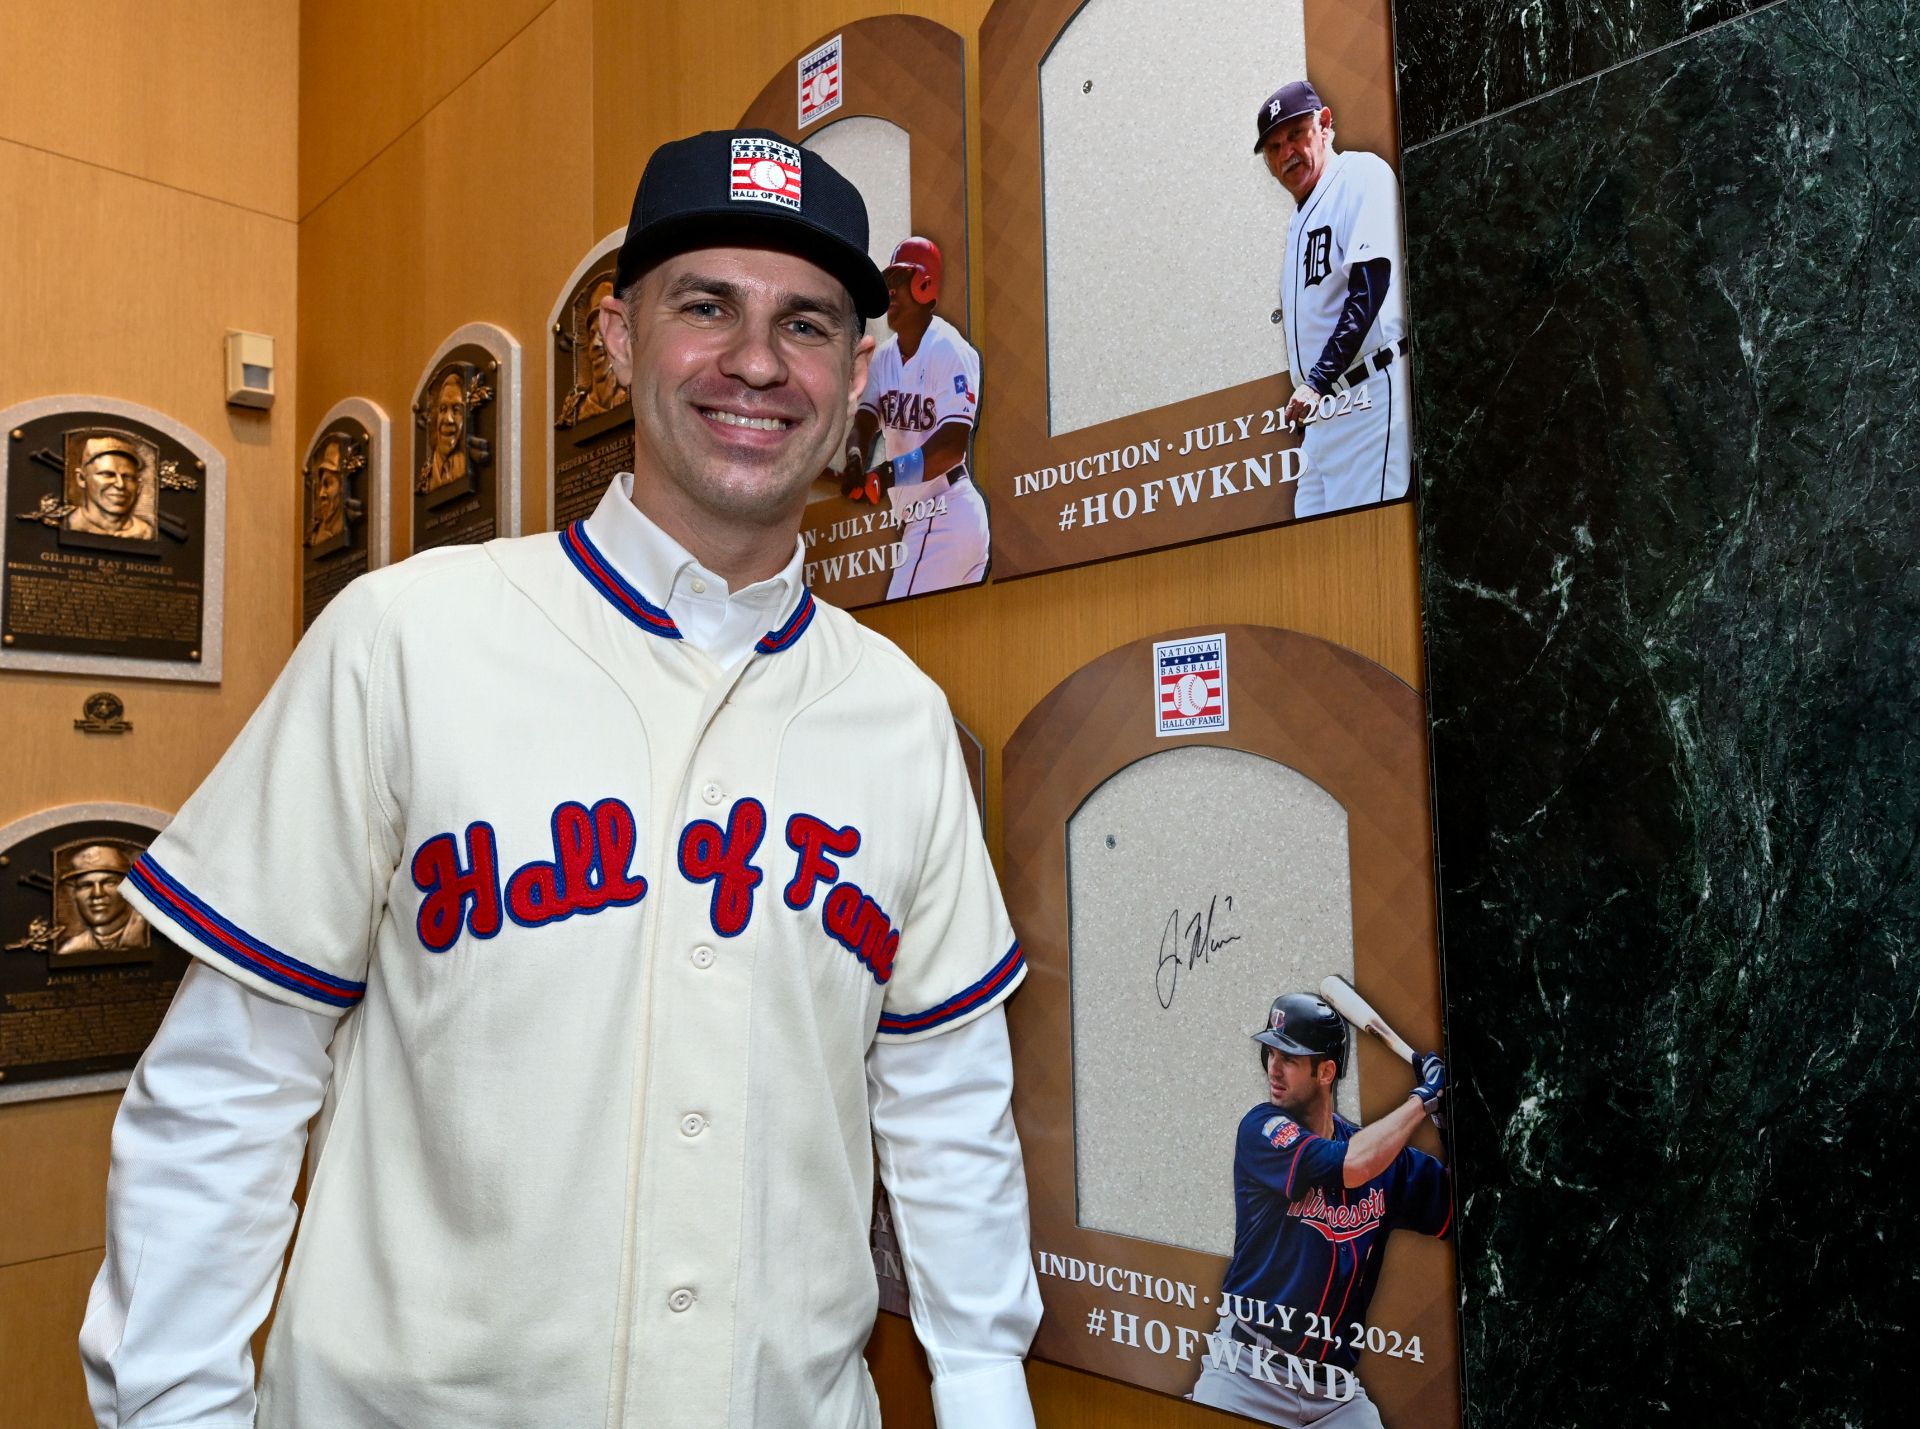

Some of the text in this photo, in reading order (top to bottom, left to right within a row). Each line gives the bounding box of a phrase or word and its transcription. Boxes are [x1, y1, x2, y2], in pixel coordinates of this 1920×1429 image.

[802, 42, 839, 69] NATIONAL
[802, 57, 838, 82] BASEBALL
[735, 139, 799, 155] NATIONAL
[735, 151, 799, 168] BASEBALL
[732, 190, 800, 209] HALL OF FAME
[1304, 225, 1332, 289] D
[1014, 383, 1373, 498] INDUCTION JULY 21, 2024
[1058, 445, 1310, 532] #HOFWKND
[828, 512, 876, 543] JULY
[879, 509, 901, 531] 21,
[905, 495, 948, 524] 2024
[40, 551, 174, 576] GILBERT RAY HODGES
[804, 540, 909, 588] FWKND
[1160, 642, 1220, 658] NATIONAL
[1160, 661, 1220, 676] BASEBALL
[1162, 715, 1222, 729] HALL OF FAME
[411, 797, 900, 985] Hall of Fame
[1038, 1250, 1425, 1364] INDUCTION JULY 21, 2024
[1086, 1306, 1358, 1403] #HOFWKND
